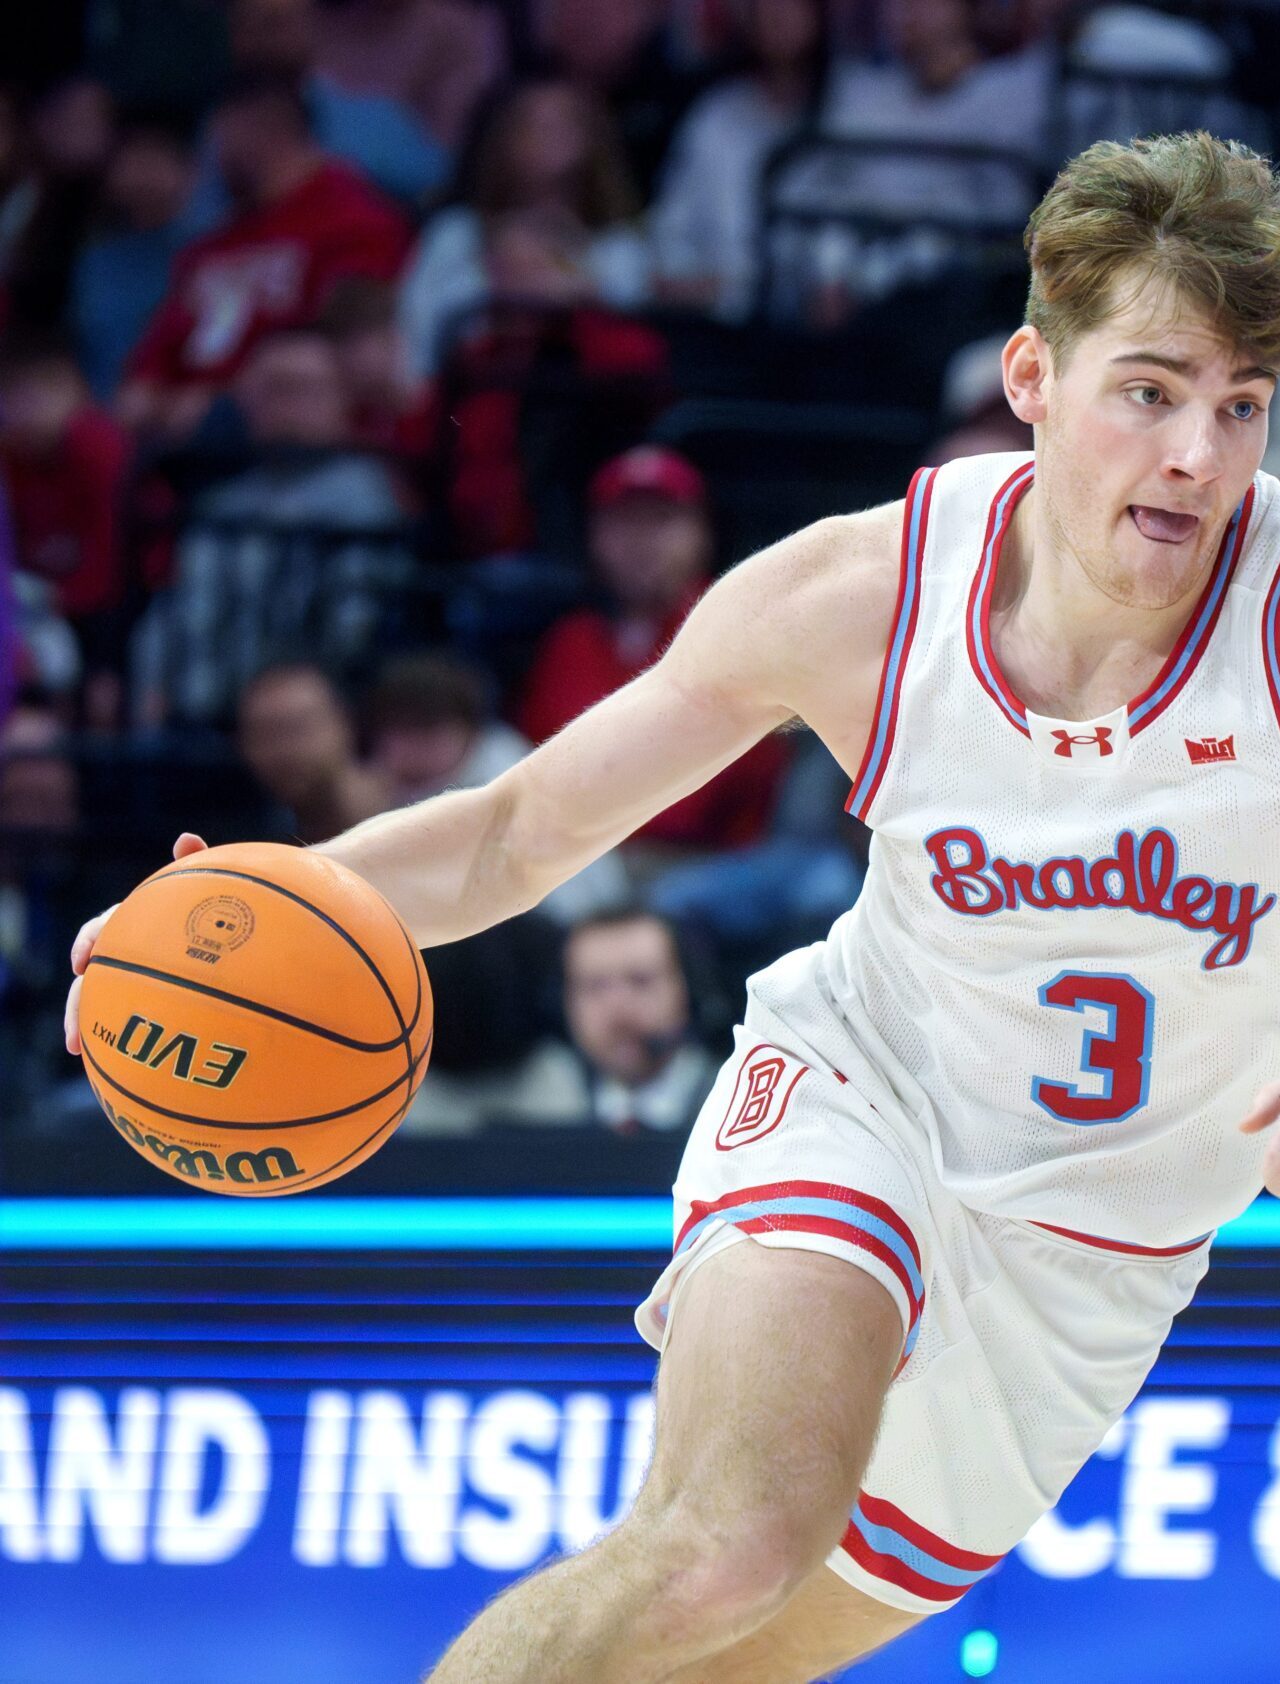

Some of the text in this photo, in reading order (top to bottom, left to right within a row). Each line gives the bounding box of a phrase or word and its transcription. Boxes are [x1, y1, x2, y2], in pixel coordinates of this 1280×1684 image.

[923, 825, 1278, 972] Bradley
[92, 1013, 248, 1090] EVO NXT
[1030, 969, 1156, 1127] 3
